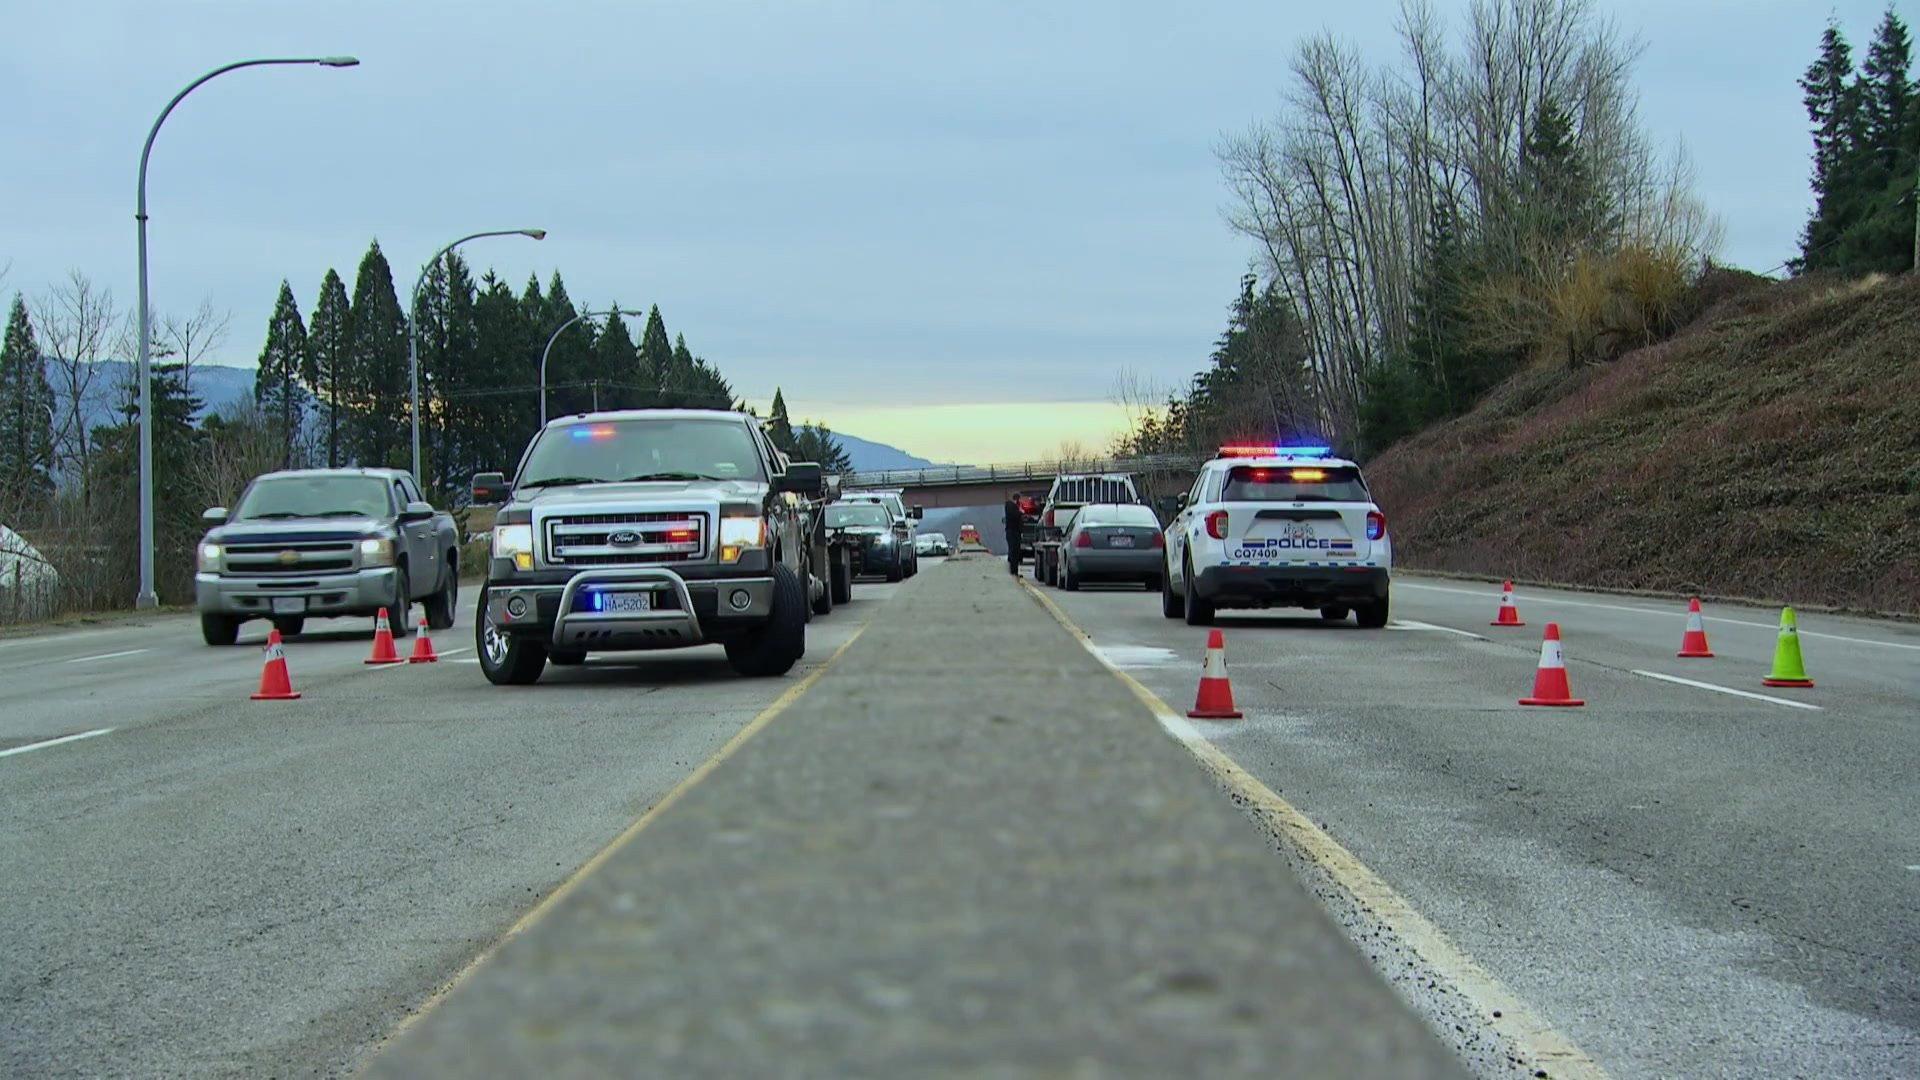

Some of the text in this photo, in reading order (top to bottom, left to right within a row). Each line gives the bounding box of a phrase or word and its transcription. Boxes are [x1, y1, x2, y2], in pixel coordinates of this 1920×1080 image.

[614, 533, 634, 542] Ford
[1266, 539, 1329, 549] POLICE
[1234, 549, 1278, 559] CQ7409
